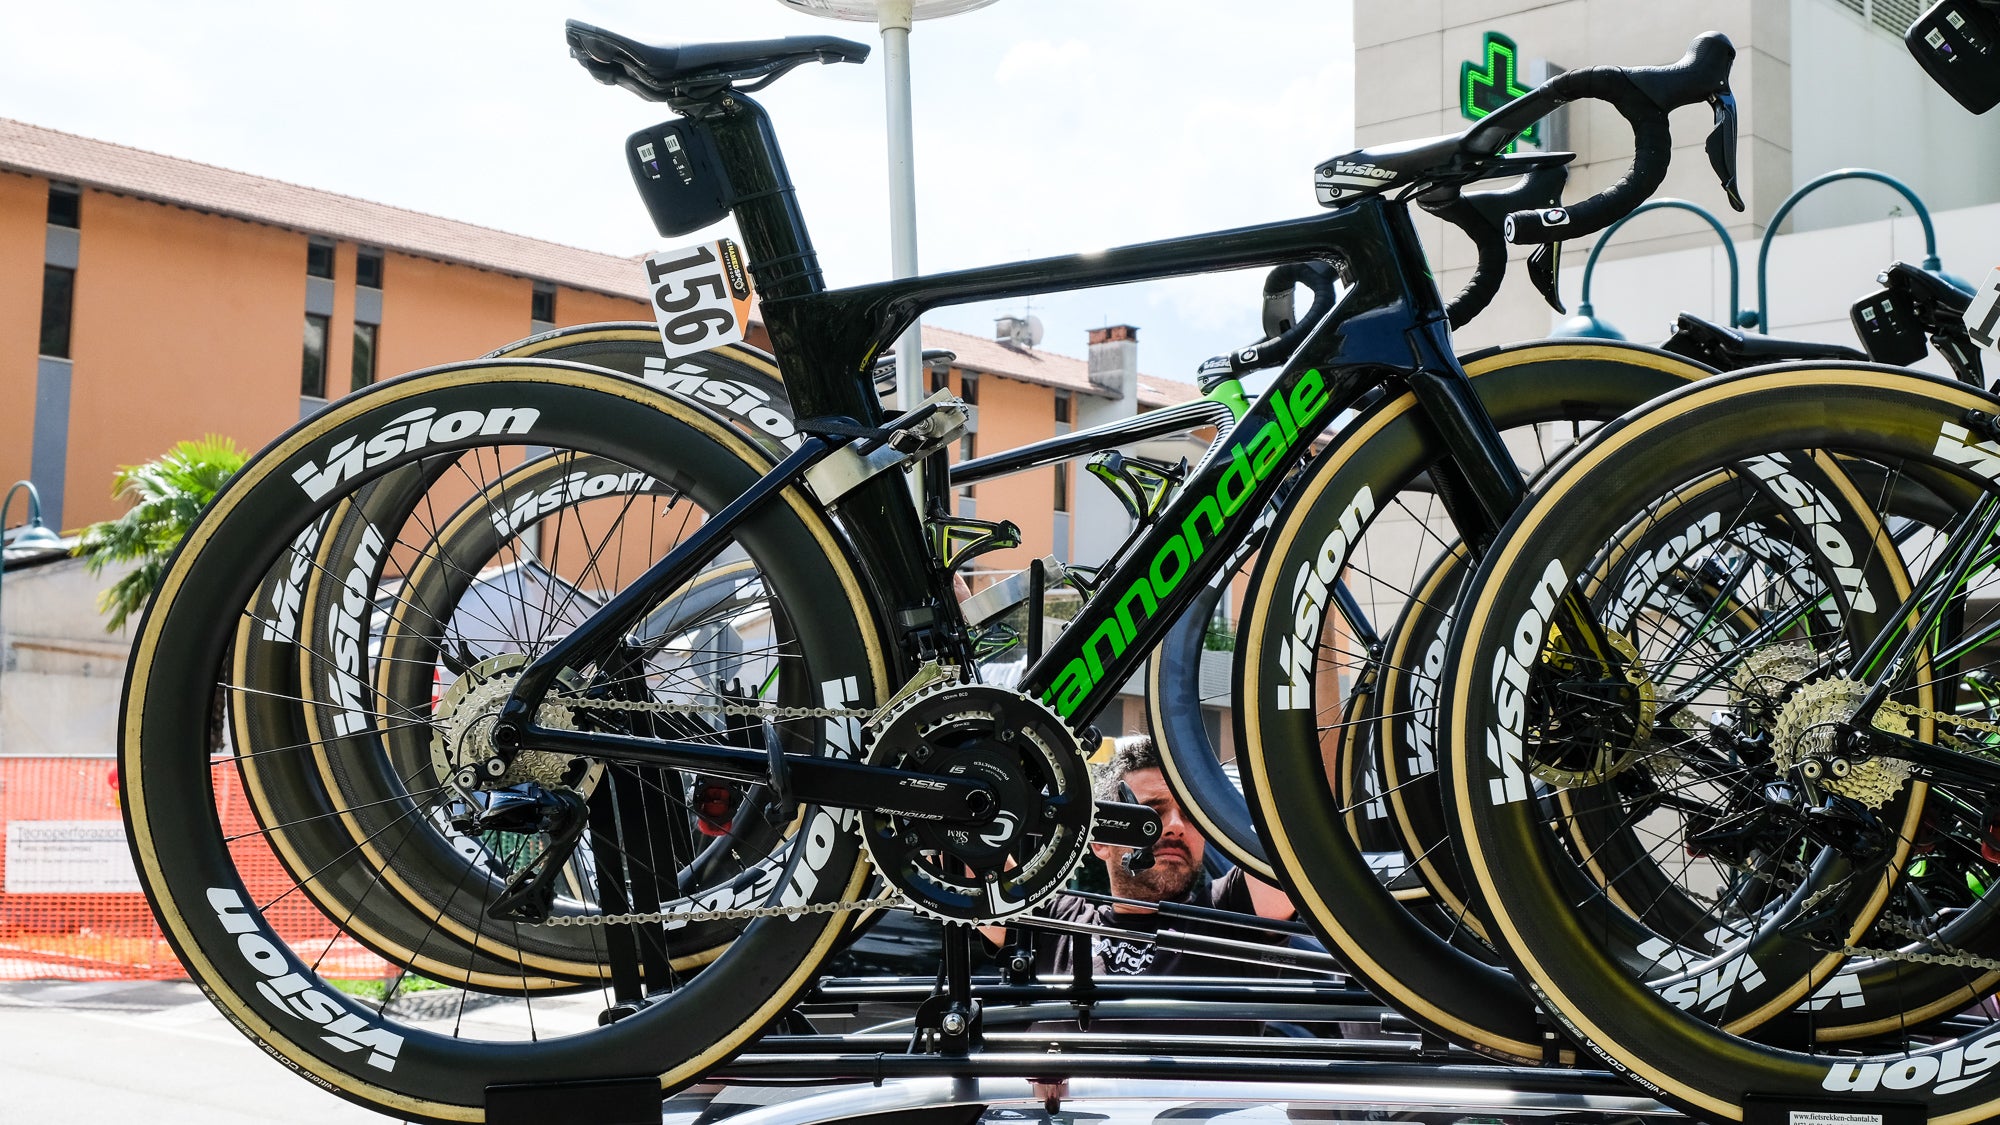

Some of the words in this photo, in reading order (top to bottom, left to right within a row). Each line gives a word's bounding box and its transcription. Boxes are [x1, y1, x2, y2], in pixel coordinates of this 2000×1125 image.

[1336, 160, 1398, 179] Vision
[646, 246, 734, 345] 156
[292, 407, 541, 502] Vision
[489, 471, 657, 537] Vision
[1042, 367, 1330, 719] annondale
[1277, 484, 1376, 711] Vision
[328, 522, 386, 738] Vision
[1487, 558, 1569, 806] Vision
[875, 806, 944, 821] cannondale
[947, 829, 969, 846] SRM
[1074, 824, 1087, 848] FULL
[1057, 850, 1077, 879] SPEED
[206, 887, 404, 1072] Vision
[258, 1039, 300, 1070] CORSA
[1586, 1038, 1627, 1072] CORSA
[303, 1070, 333, 1090] vittoria
[1629, 1072, 1660, 1093] vittoria
